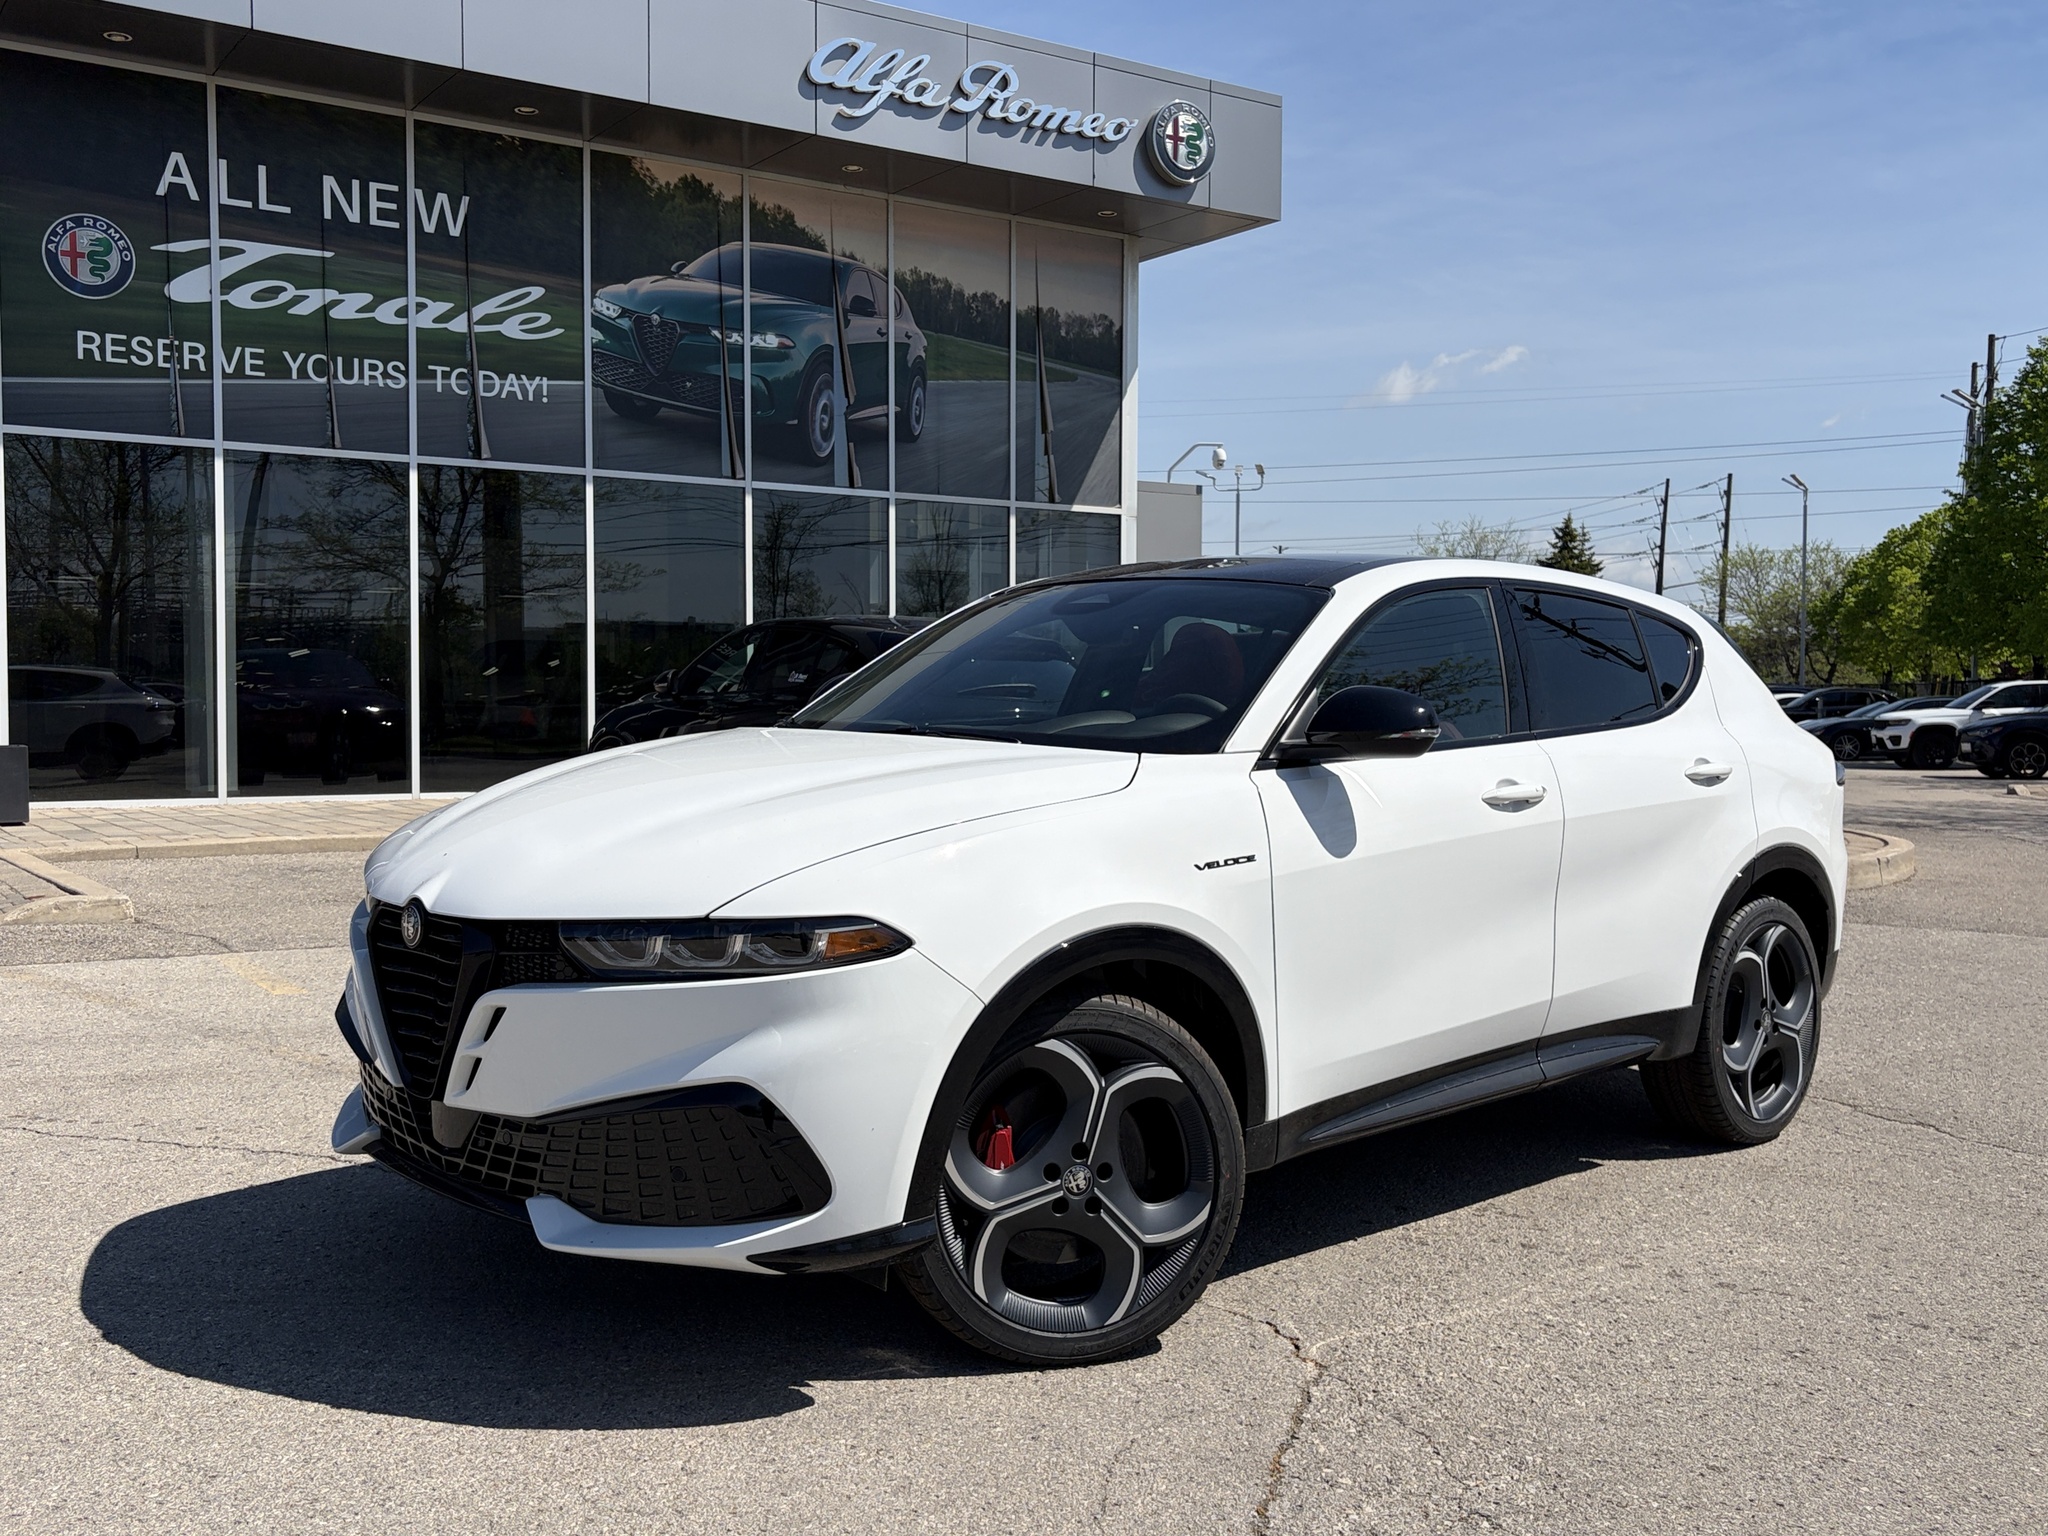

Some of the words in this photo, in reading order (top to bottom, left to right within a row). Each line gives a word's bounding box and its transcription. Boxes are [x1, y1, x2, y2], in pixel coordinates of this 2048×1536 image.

[807, 37, 951, 118] Alfa
[950, 60, 1139, 142] Romeo
[1156, 106, 1178, 138] ALFA
[155, 151, 292, 214] ALL
[322, 174, 470, 238] NEW
[47, 220, 76, 253] ALFA
[83, 217, 131, 262] ROMEO
[150, 238, 565, 341] Tonale
[76, 330, 266, 377] RESERVE
[282, 350, 407, 390] YOURS
[1193, 854, 1257, 871] VELOCE
